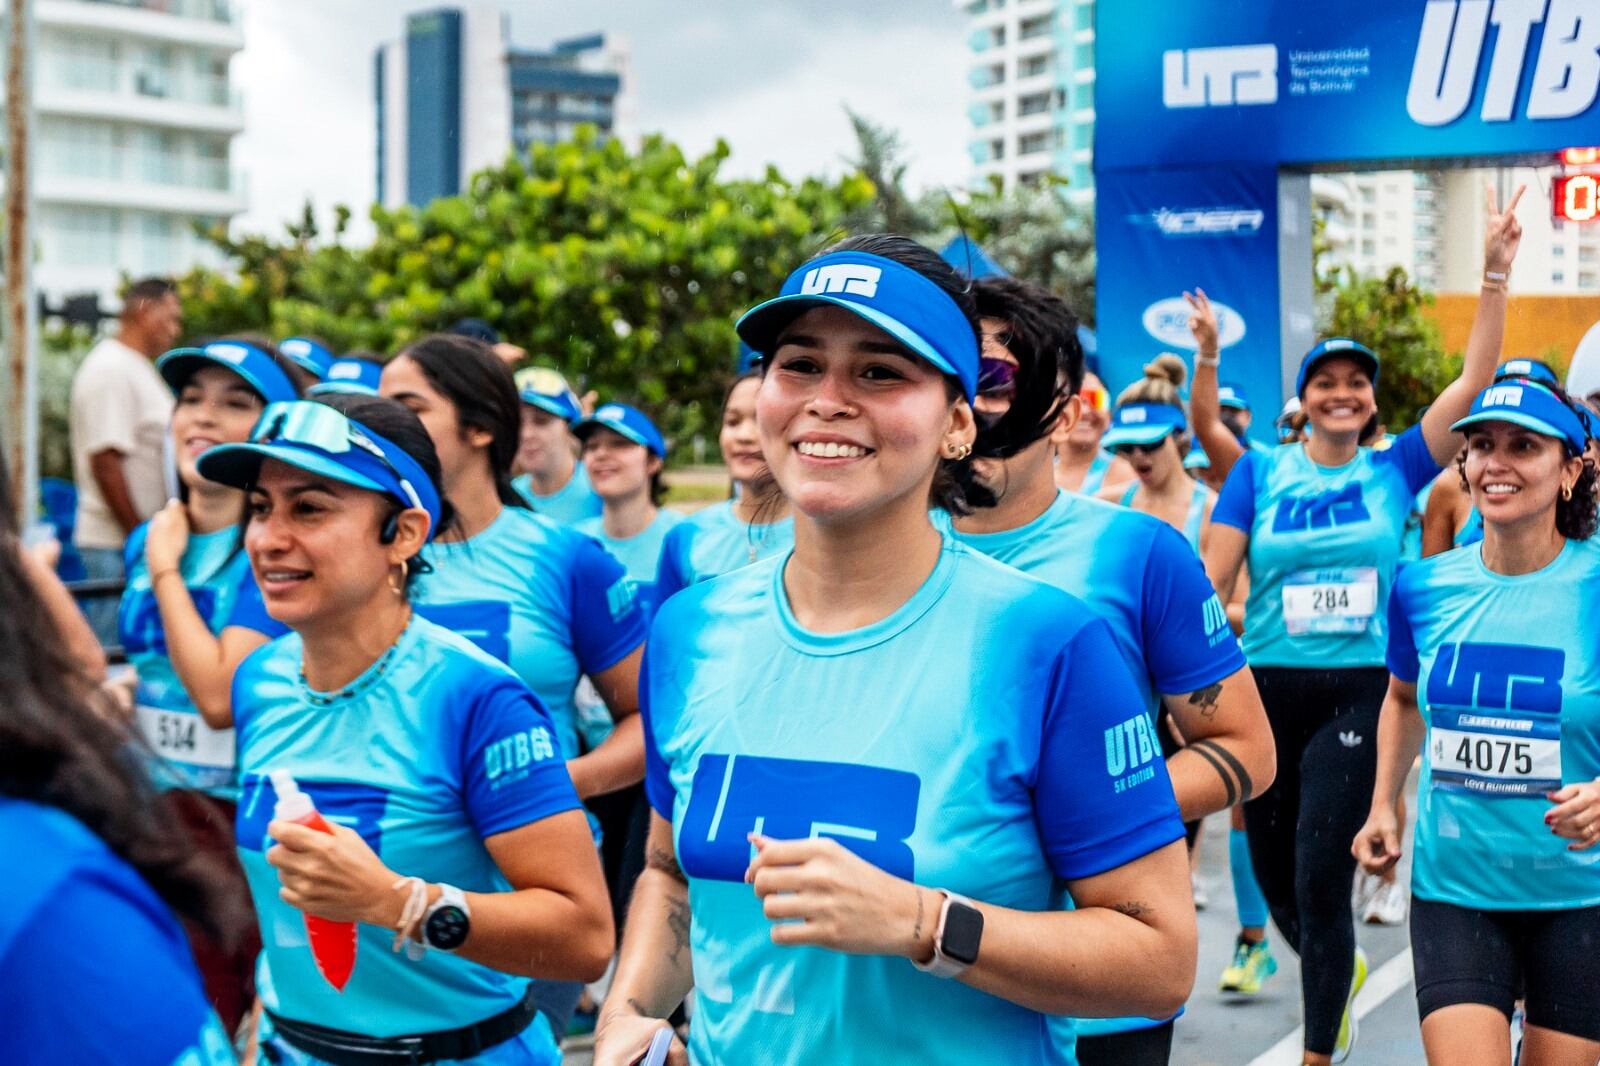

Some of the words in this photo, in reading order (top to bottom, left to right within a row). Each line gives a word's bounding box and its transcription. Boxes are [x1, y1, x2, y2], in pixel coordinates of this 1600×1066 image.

[1163, 43, 1278, 108] UTB
[800, 263, 882, 298] UTB
[1481, 386, 1523, 408] UTB
[1312, 587, 1350, 611] 284
[1427, 642, 1566, 715] UTB
[1455, 737, 1533, 775] 4075
[1114, 778, 1127, 794] 5K
[1128, 765, 1155, 788] EDITION
[1464, 778, 1486, 791] LOVE
[1486, 782, 1529, 794] RUNNING
